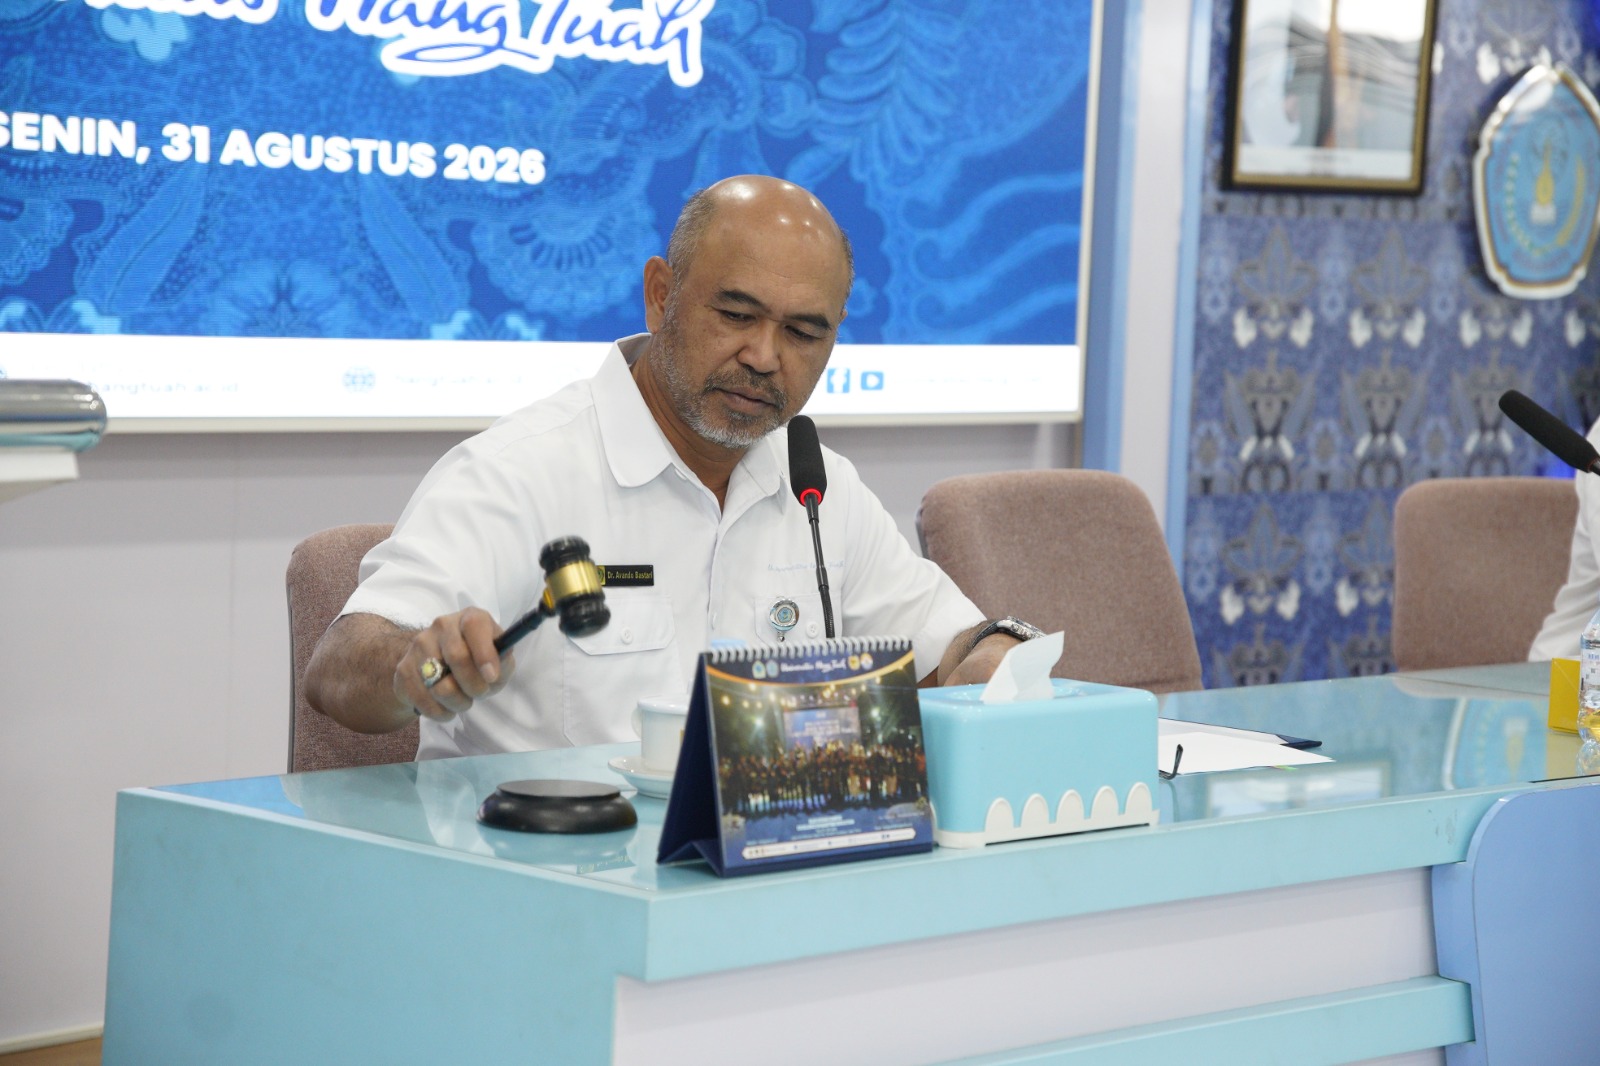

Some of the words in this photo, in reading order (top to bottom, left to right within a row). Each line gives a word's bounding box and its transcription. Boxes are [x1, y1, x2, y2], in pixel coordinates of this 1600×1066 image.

[308, 0, 550, 72] ang
[161, 122, 210, 163] 31
[219, 128, 437, 179] AGUSTUS
[443, 143, 547, 185] 2026
[607, 571, 615, 579] Dr.
